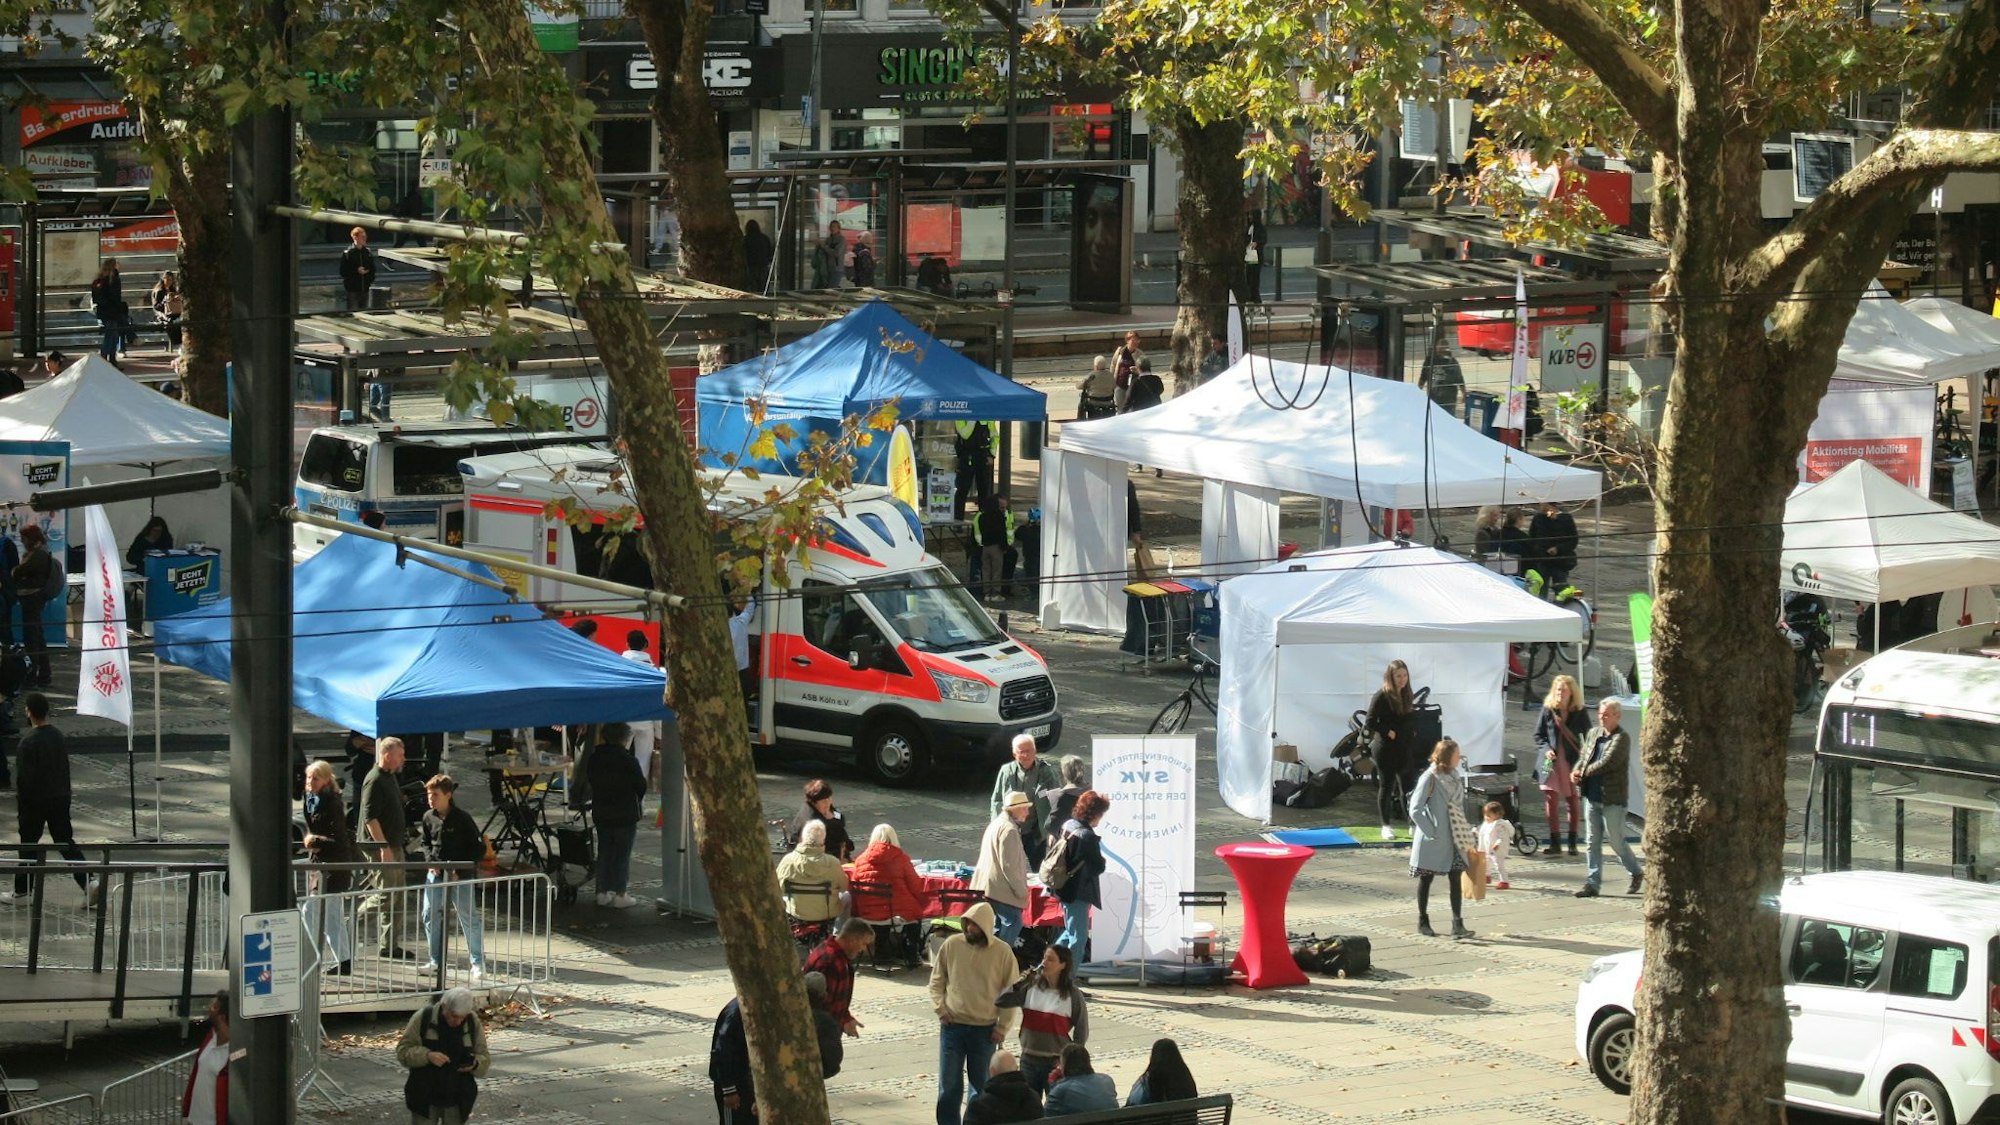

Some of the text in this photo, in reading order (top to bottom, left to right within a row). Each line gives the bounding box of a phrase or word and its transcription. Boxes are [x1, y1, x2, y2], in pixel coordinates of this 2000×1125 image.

[708, 89, 744, 97] ACTORY
[24, 103, 120, 139] Baerdruck
[91, 122, 141, 139] Aufkl
[28, 153, 93, 169] Aufkleber
[1548, 349, 1577, 365] KVB
[938, 400, 969, 409] POLIZEI
[1811, 443, 1908, 457] Aktionstag Mobilität
[327, 495, 361, 512] POLIZEI
[181, 569, 202, 580] ECHT
[801, 692, 818, 702] ASB
[819, 695, 836, 705] Köln
